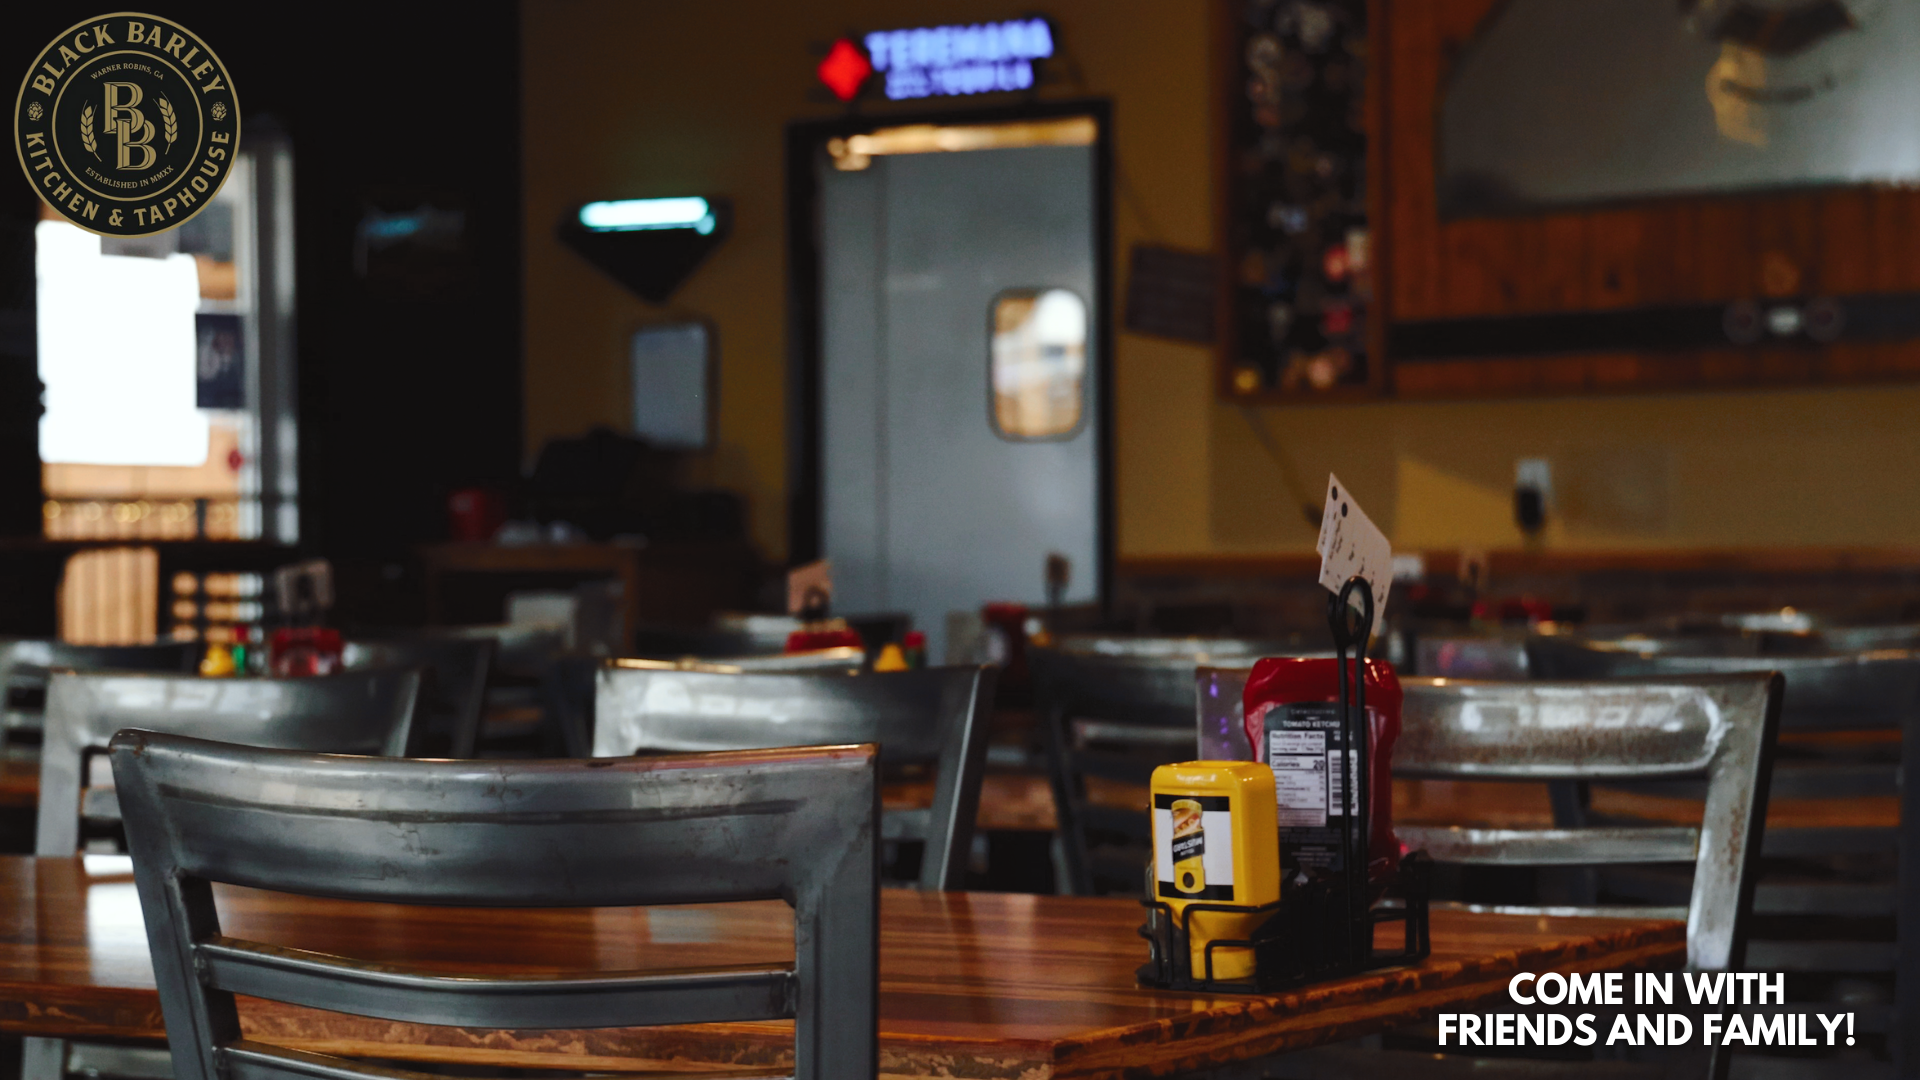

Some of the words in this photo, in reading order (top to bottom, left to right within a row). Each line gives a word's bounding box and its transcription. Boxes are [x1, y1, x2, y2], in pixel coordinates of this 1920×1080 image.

[1283, 720, 1311, 728] TOMATO
[1312, 720, 1341, 728] KETCHU
[1304, 732, 1324, 740] Facts
[1272, 760, 1300, 768] Calories
[1313, 760, 1325, 771] 20
